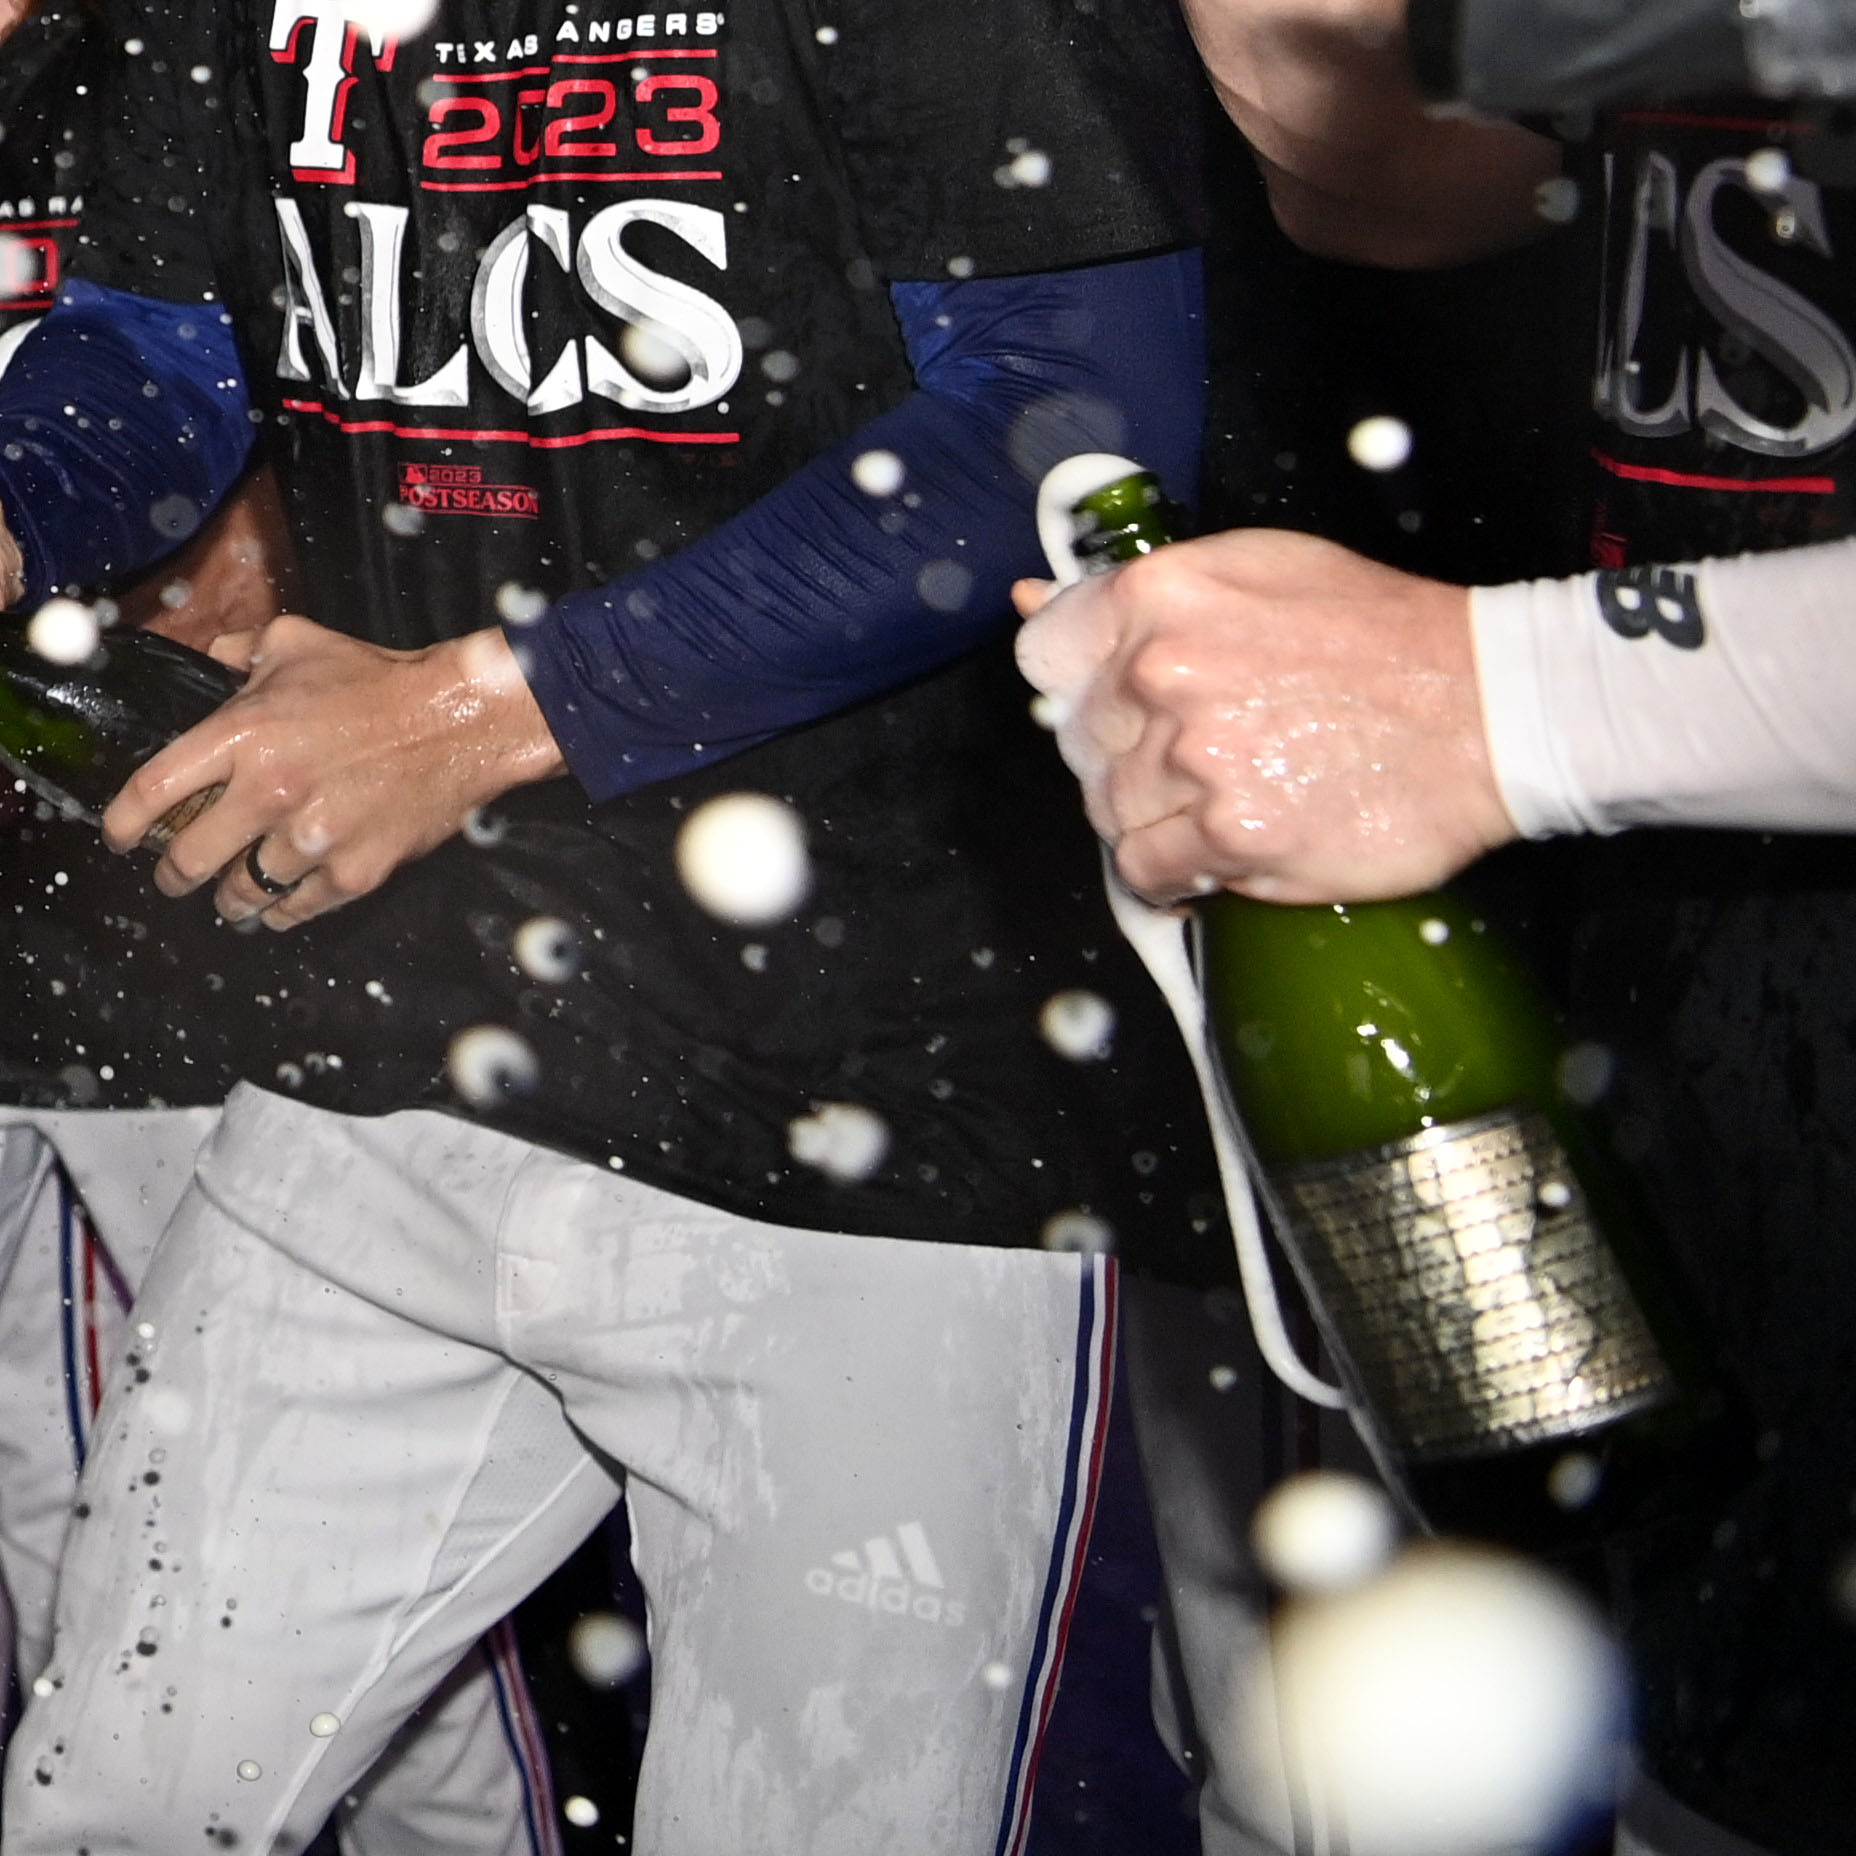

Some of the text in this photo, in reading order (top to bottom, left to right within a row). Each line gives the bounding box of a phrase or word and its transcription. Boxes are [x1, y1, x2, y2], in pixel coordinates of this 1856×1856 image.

[421, 74, 721, 170] 2023
[275, 198, 744, 416] ALCS
[400, 483, 540, 514] POSTSEASON
[429, 468, 482, 484] 2023
[803, 1567, 969, 1627] adidas
